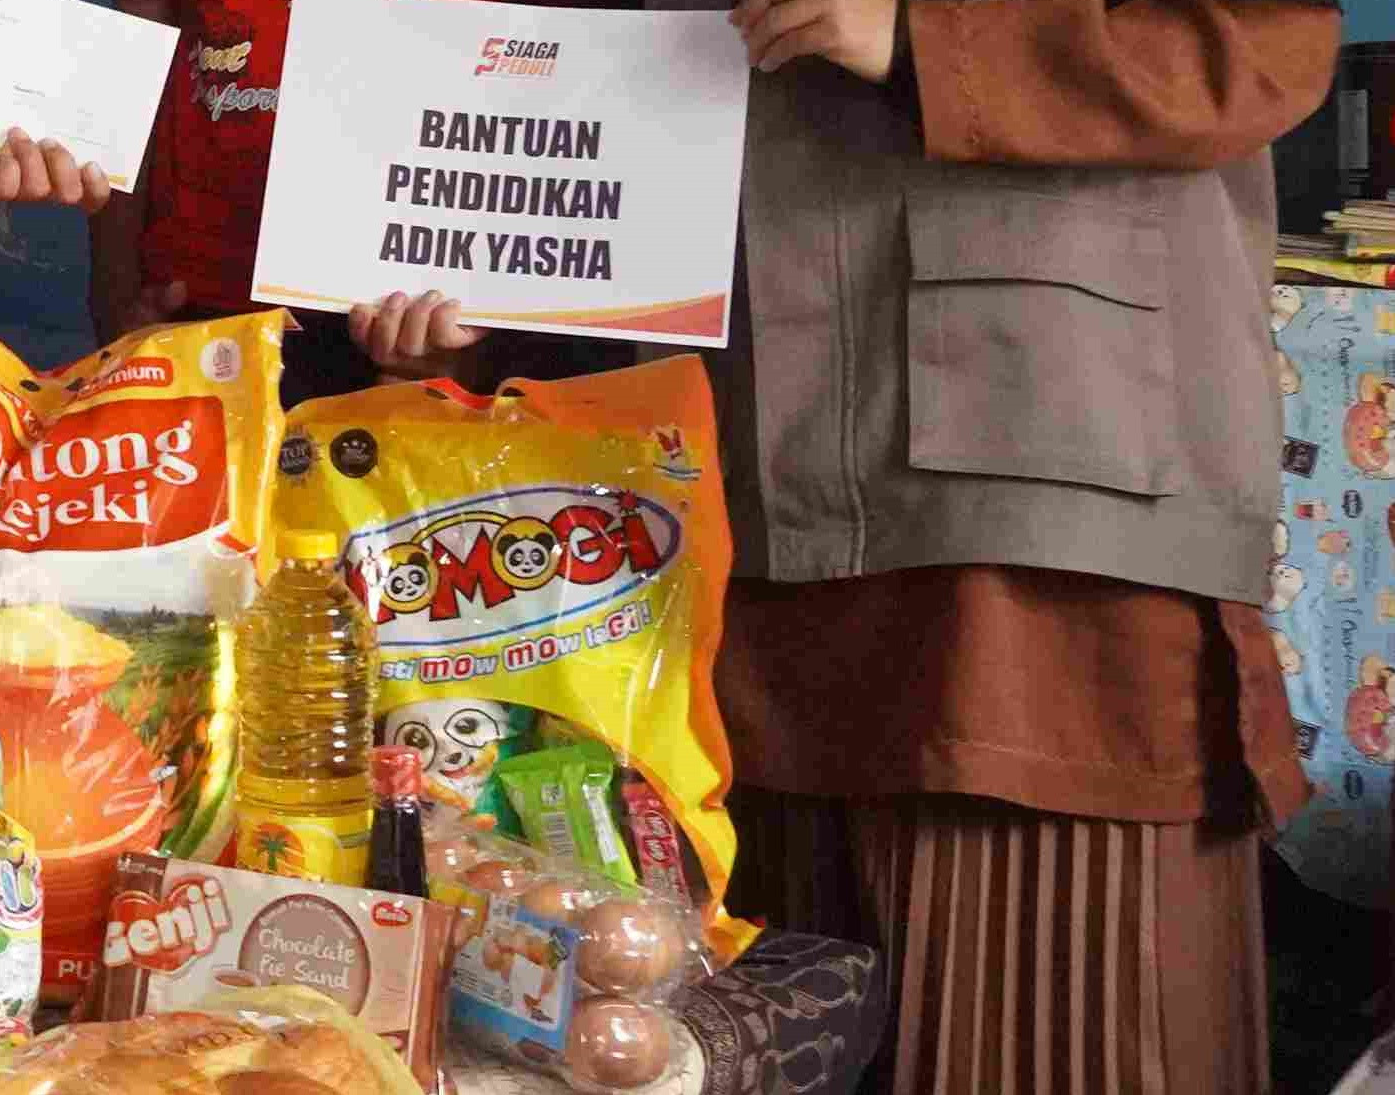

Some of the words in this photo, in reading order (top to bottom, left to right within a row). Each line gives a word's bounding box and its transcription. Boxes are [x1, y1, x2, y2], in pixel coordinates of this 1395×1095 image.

[504, 39, 560, 60] SIAGA
[419, 108, 602, 161] BANTUAN
[385, 163, 622, 221] PENDIDIKAN
[379, 222, 480, 271] ADIK
[485, 231, 614, 281] YASHA
[421, 654, 498, 683] mow
[505, 632, 580, 672] mow
[259, 928, 357, 965] Chocolate
[58, 959, 95, 982] PU
[292, 960, 349, 993] Sand
